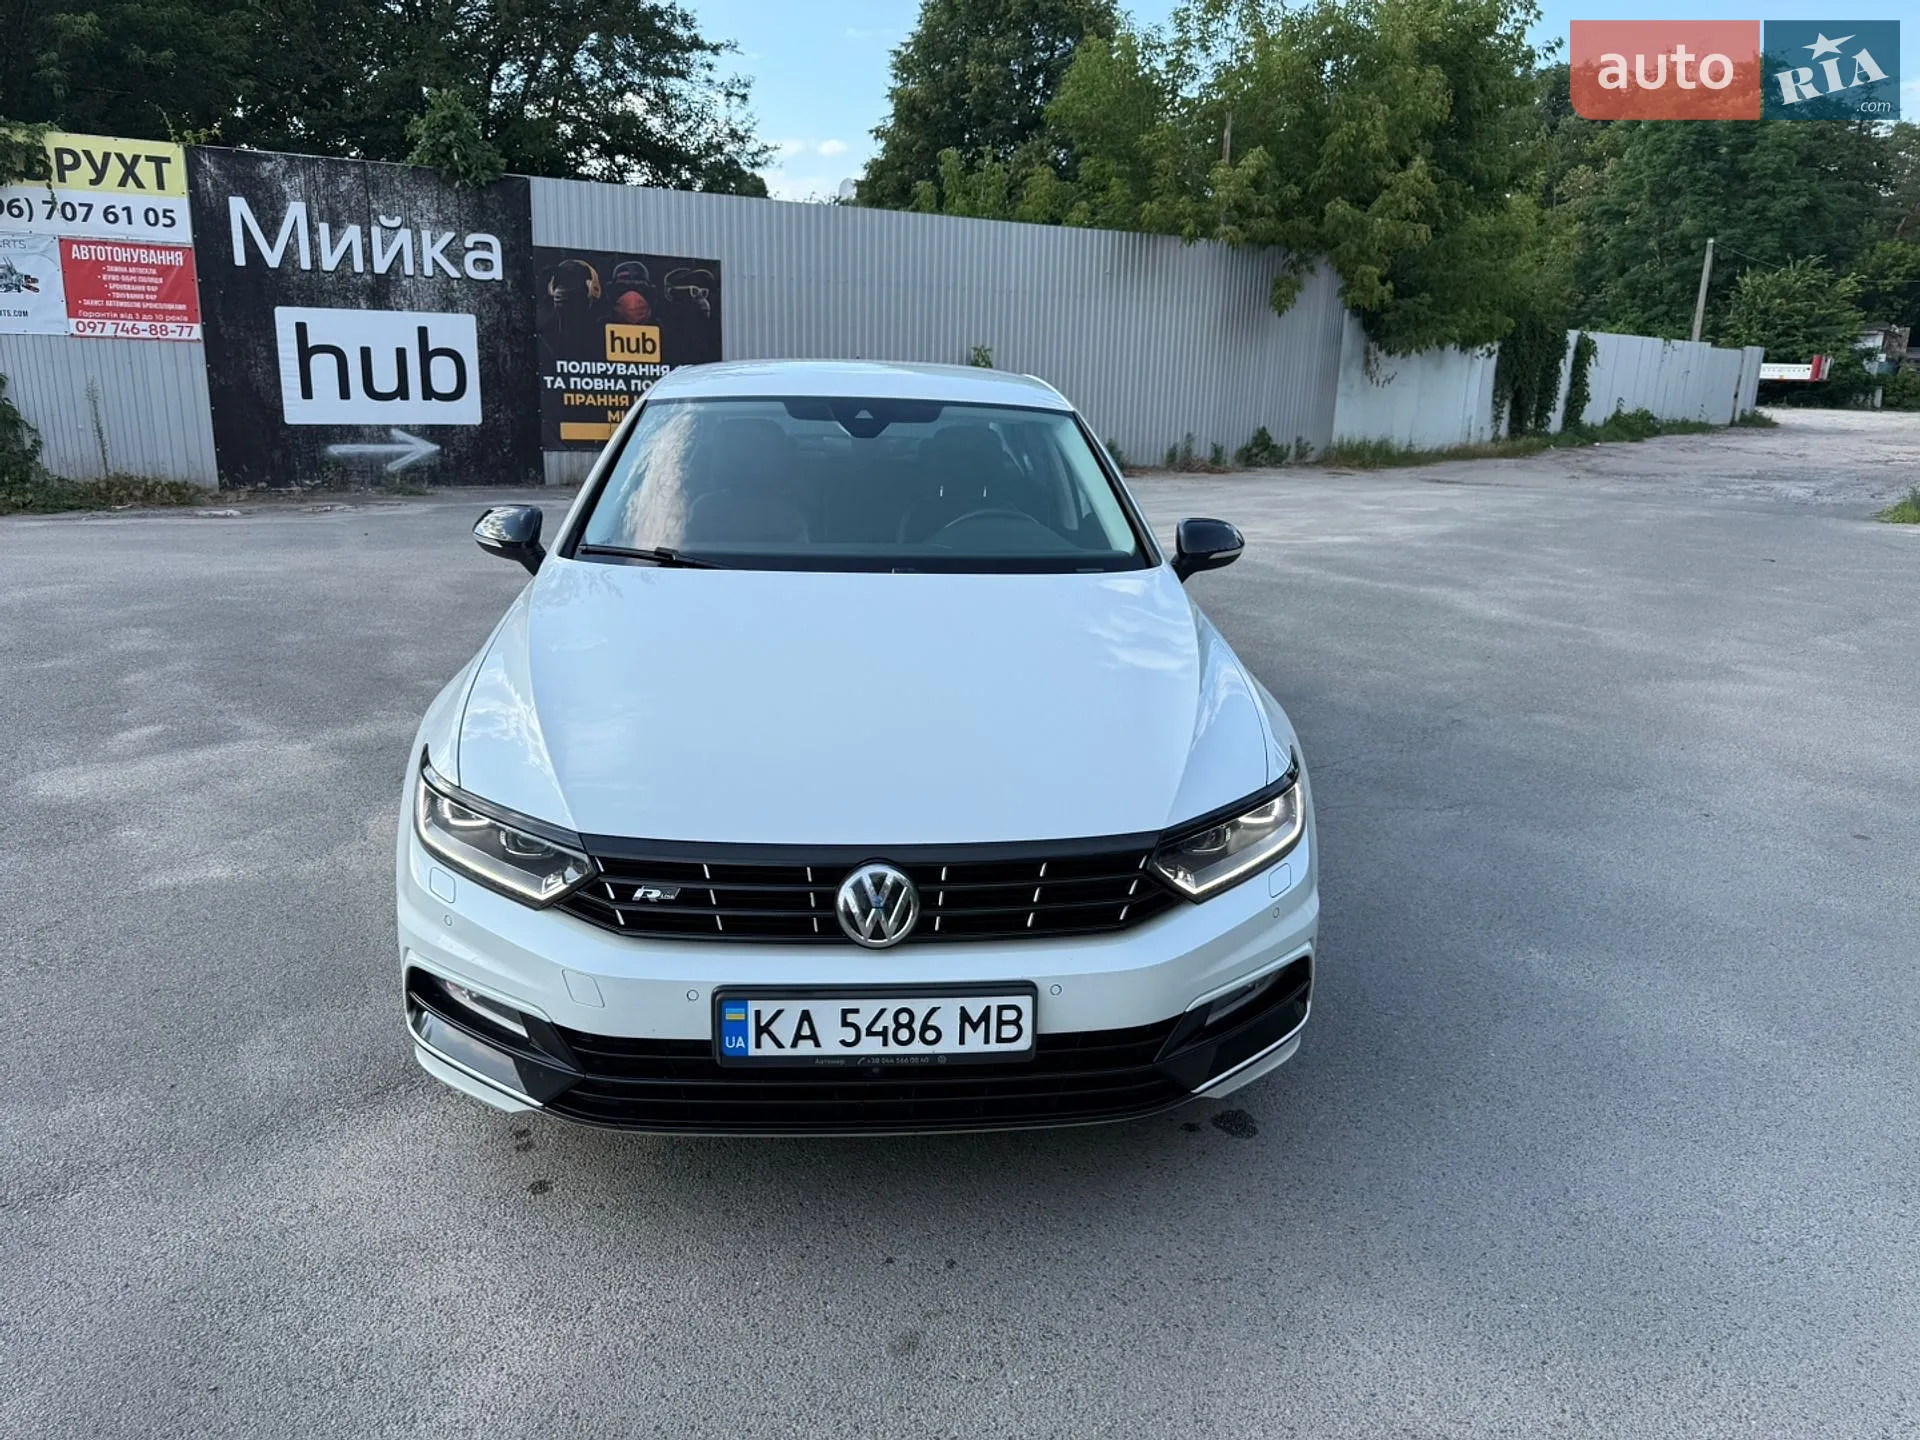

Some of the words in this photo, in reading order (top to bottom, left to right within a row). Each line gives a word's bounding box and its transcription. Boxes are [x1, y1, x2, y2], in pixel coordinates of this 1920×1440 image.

[41, 200, 94, 222] 707
[102, 205, 133, 225] 61
[143, 207, 177, 228] 05
[0, 238, 27, 249] RTS
[228, 196, 504, 281] Мийка
[71, 244, 184, 266] АВТОТОНУВАННЯ
[75, 320, 107, 334] 097
[110, 322, 194, 337] 746-88-77
[609, 330, 658, 354] hub
[295, 321, 467, 402] hub
[556, 360, 671, 376] ПОЛІРУВАННЯ
[543, 376, 566, 389] ТА
[569, 377, 627, 391] ПОВНА
[631, 380, 656, 392] ПО
[563, 393, 629, 406] ПРАННЯ
[754, 1008, 822, 1049] KA
[839, 1006, 942, 1048] 5486
[958, 1004, 1024, 1046] MB
[725, 1036, 746, 1049] UA
